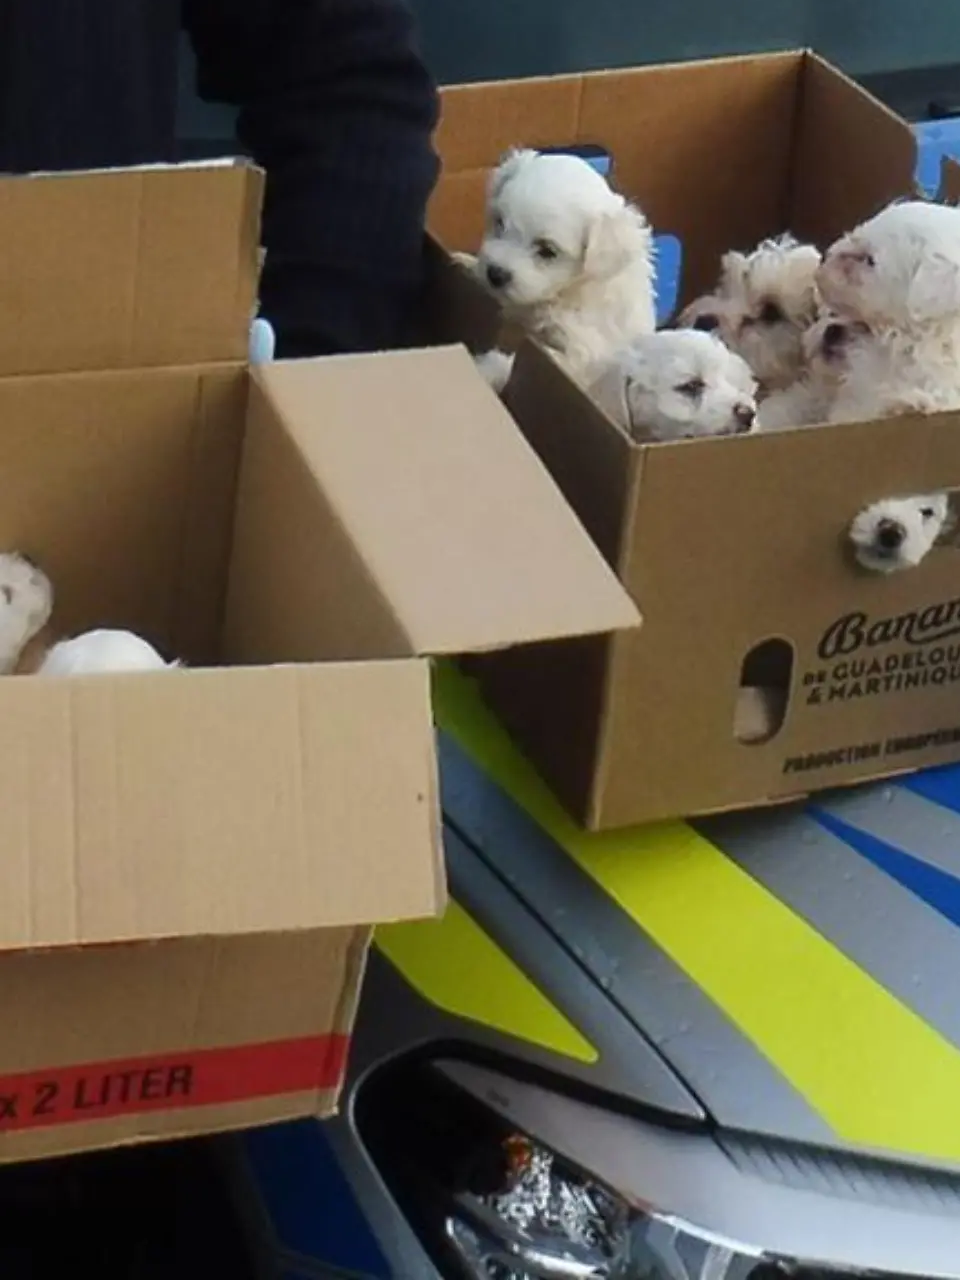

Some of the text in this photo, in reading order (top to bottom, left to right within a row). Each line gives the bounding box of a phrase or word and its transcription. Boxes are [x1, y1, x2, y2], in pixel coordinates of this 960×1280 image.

[806, 688, 822, 705] &
[33, 1081, 60, 1116] 2
[73, 1064, 193, 1109] LITER
